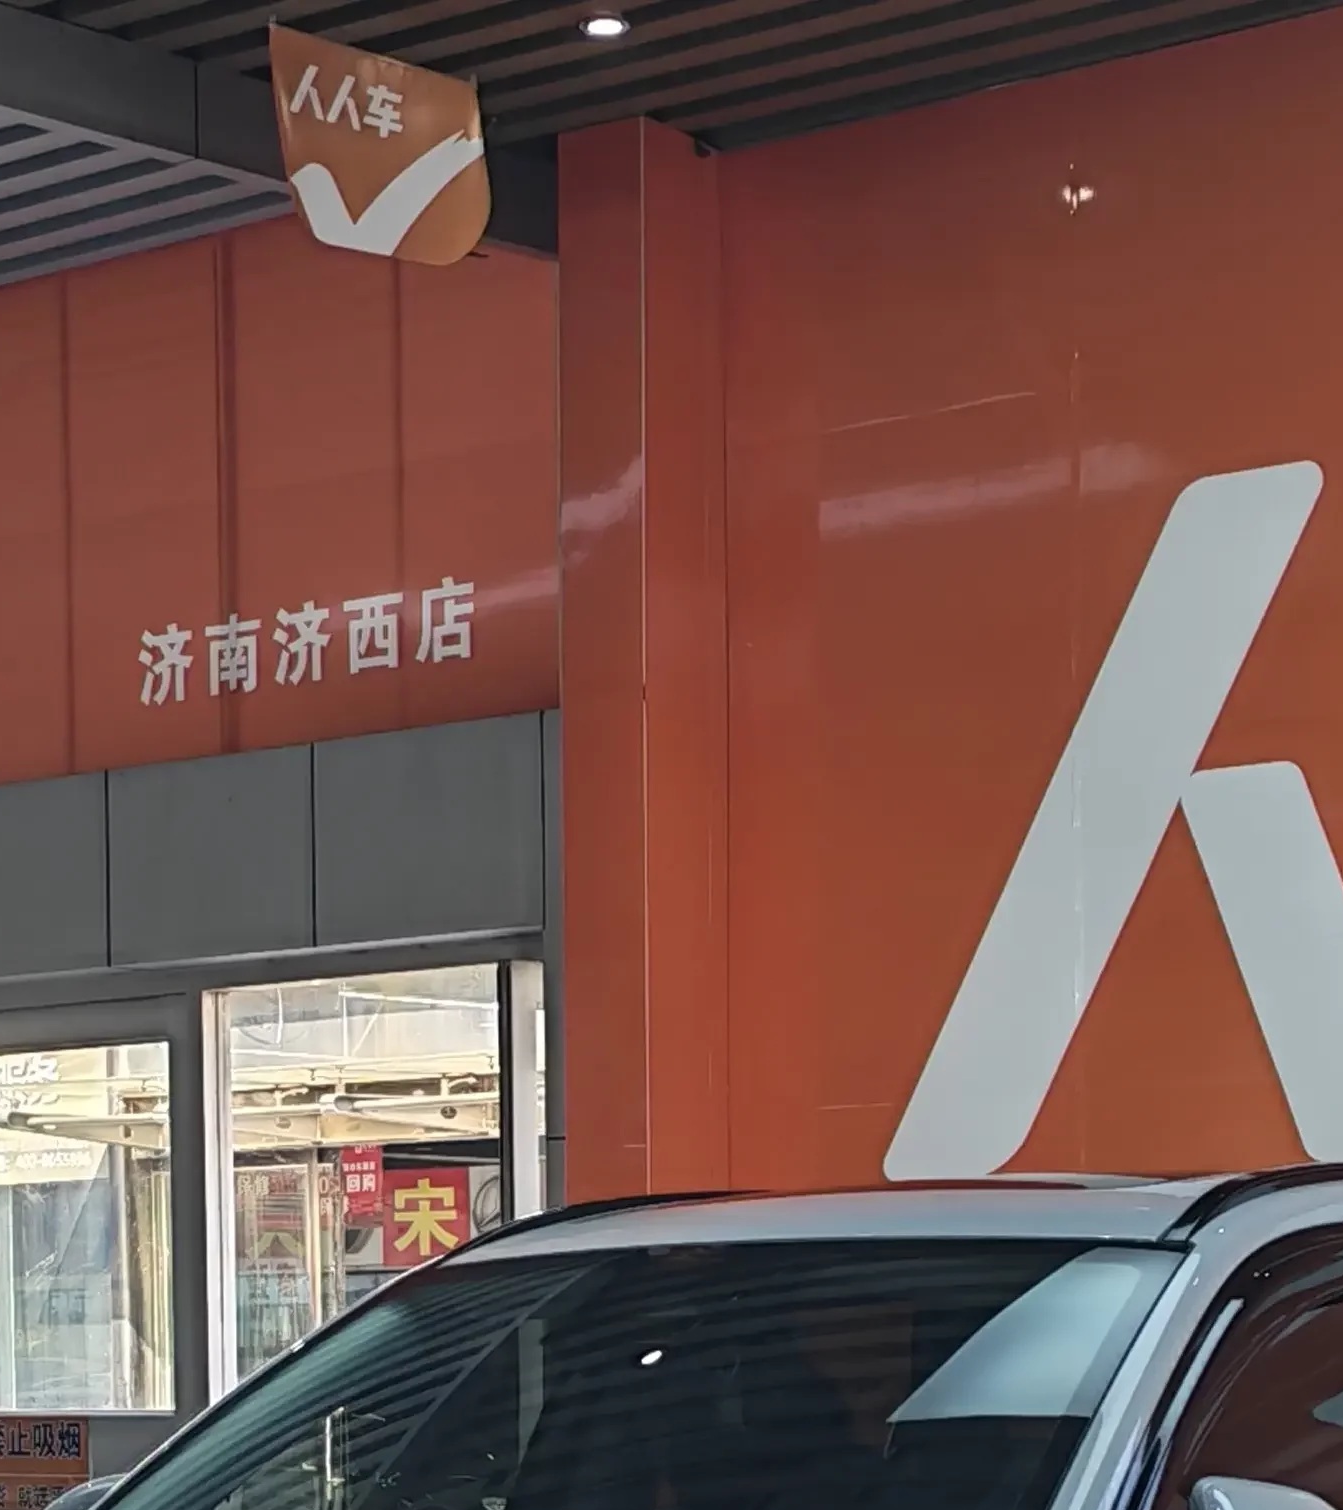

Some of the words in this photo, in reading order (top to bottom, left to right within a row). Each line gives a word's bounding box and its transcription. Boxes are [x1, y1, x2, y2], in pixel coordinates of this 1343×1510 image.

[289, 64, 404, 138] 人人车
[138, 576, 474, 706] 济南济西店
[394, 1178, 460, 1257] 宋
